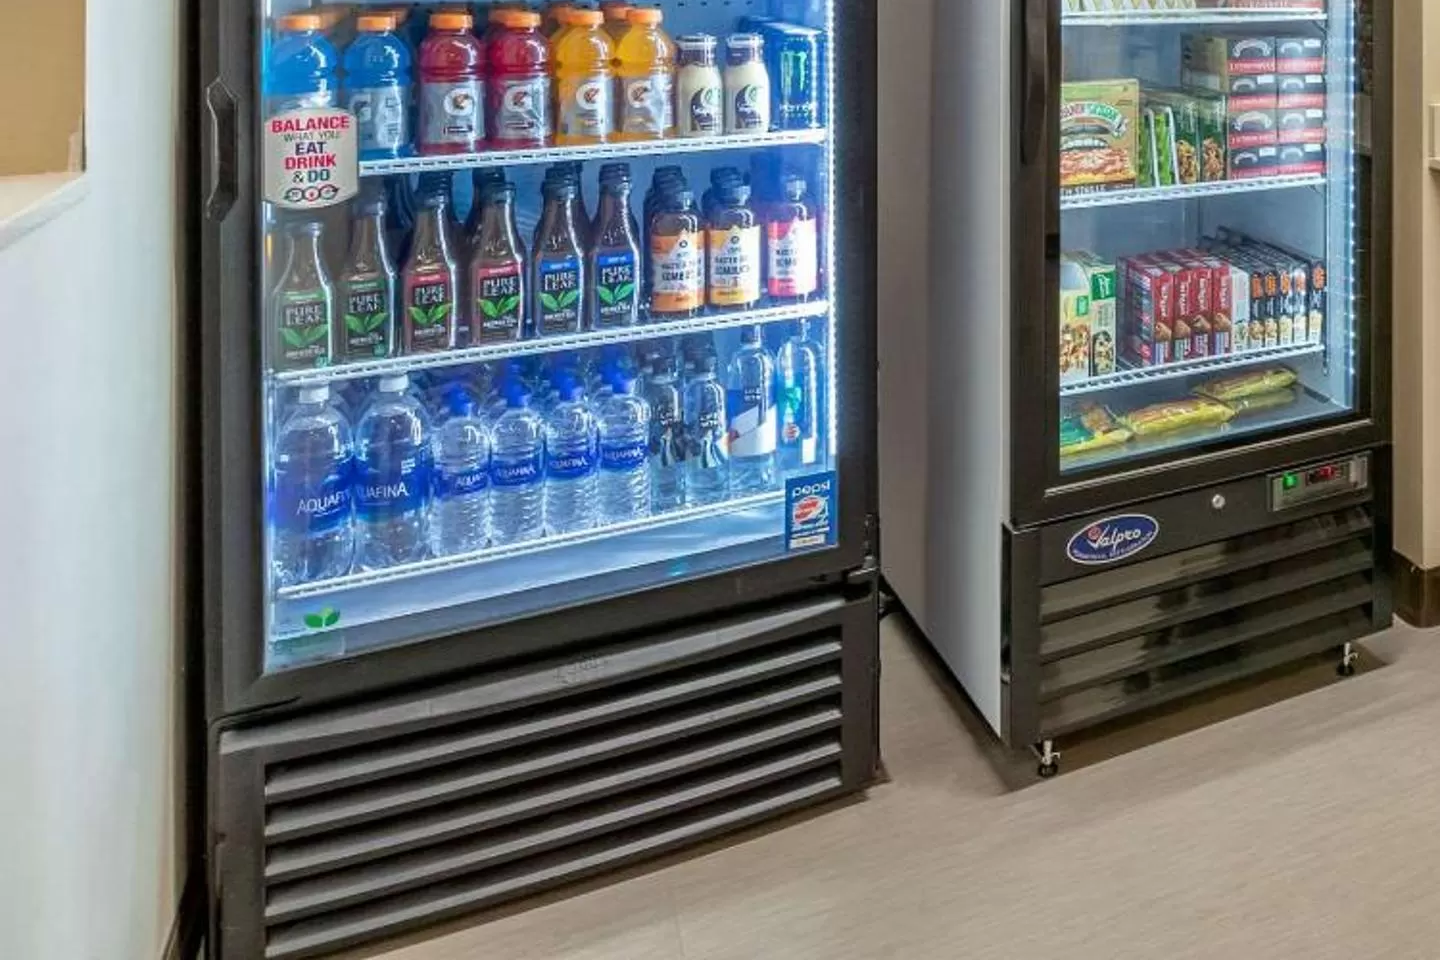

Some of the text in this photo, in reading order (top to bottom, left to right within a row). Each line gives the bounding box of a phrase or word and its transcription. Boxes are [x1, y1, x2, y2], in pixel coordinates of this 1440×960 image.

[271, 115, 350, 133] BALANCE
[295, 141, 328, 156] EAT
[285, 153, 337, 170] DRINK
[308, 168, 330, 182] DO
[792, 480, 830, 498] pepsi
[1087, 524, 1141, 553] Valpro
